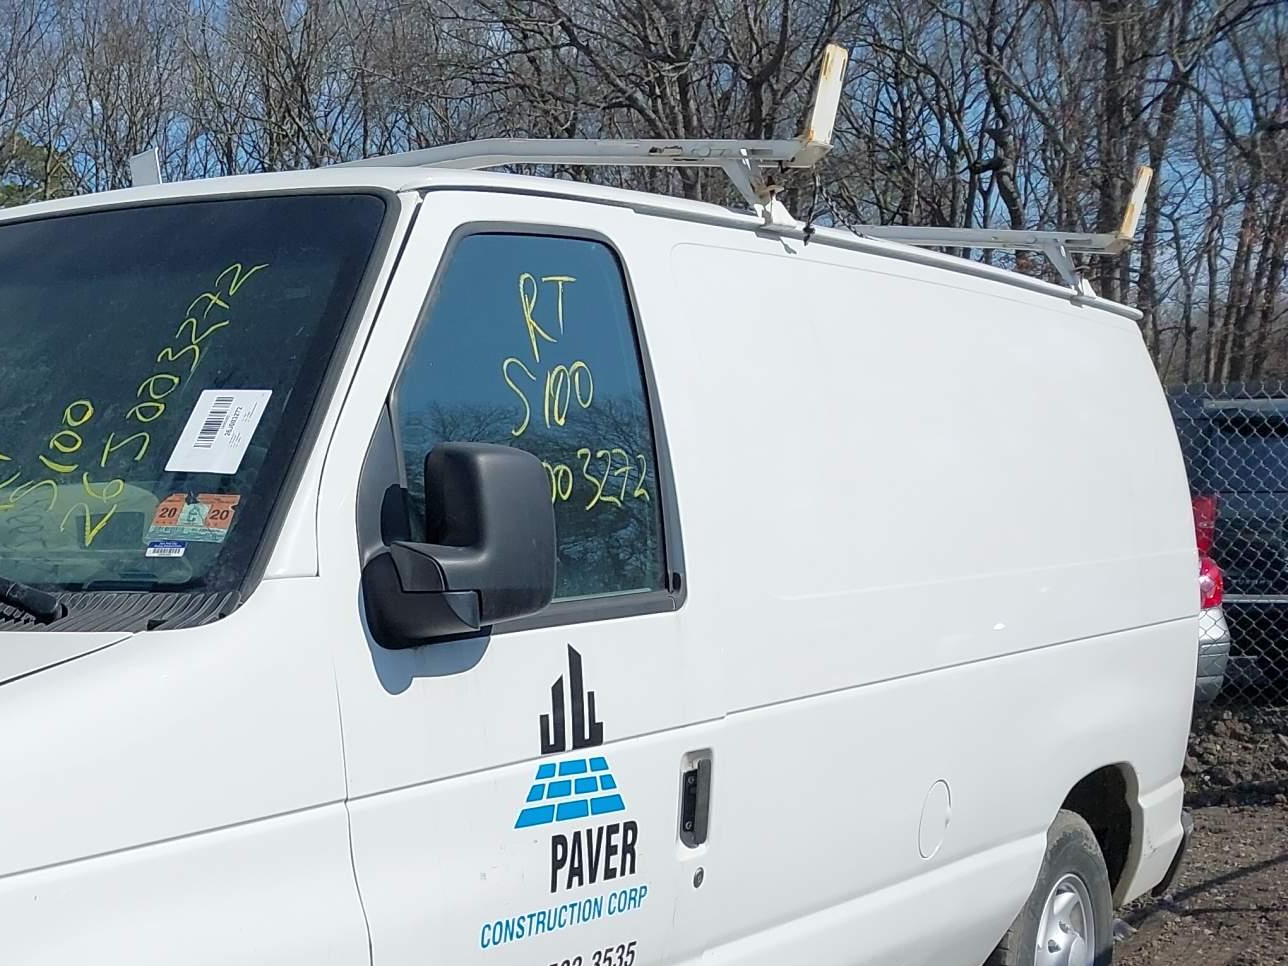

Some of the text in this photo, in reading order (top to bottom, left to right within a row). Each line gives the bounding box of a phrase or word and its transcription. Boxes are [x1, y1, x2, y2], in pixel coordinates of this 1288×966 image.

[519, 272, 577, 363] RT
[502, 357, 594, 436] S100
[159, 507, 178, 519] 20
[209, 509, 230, 521] 20
[550, 820, 638, 894] PAVER
[480, 885, 649, 950] CONSTRUCTION CORP
